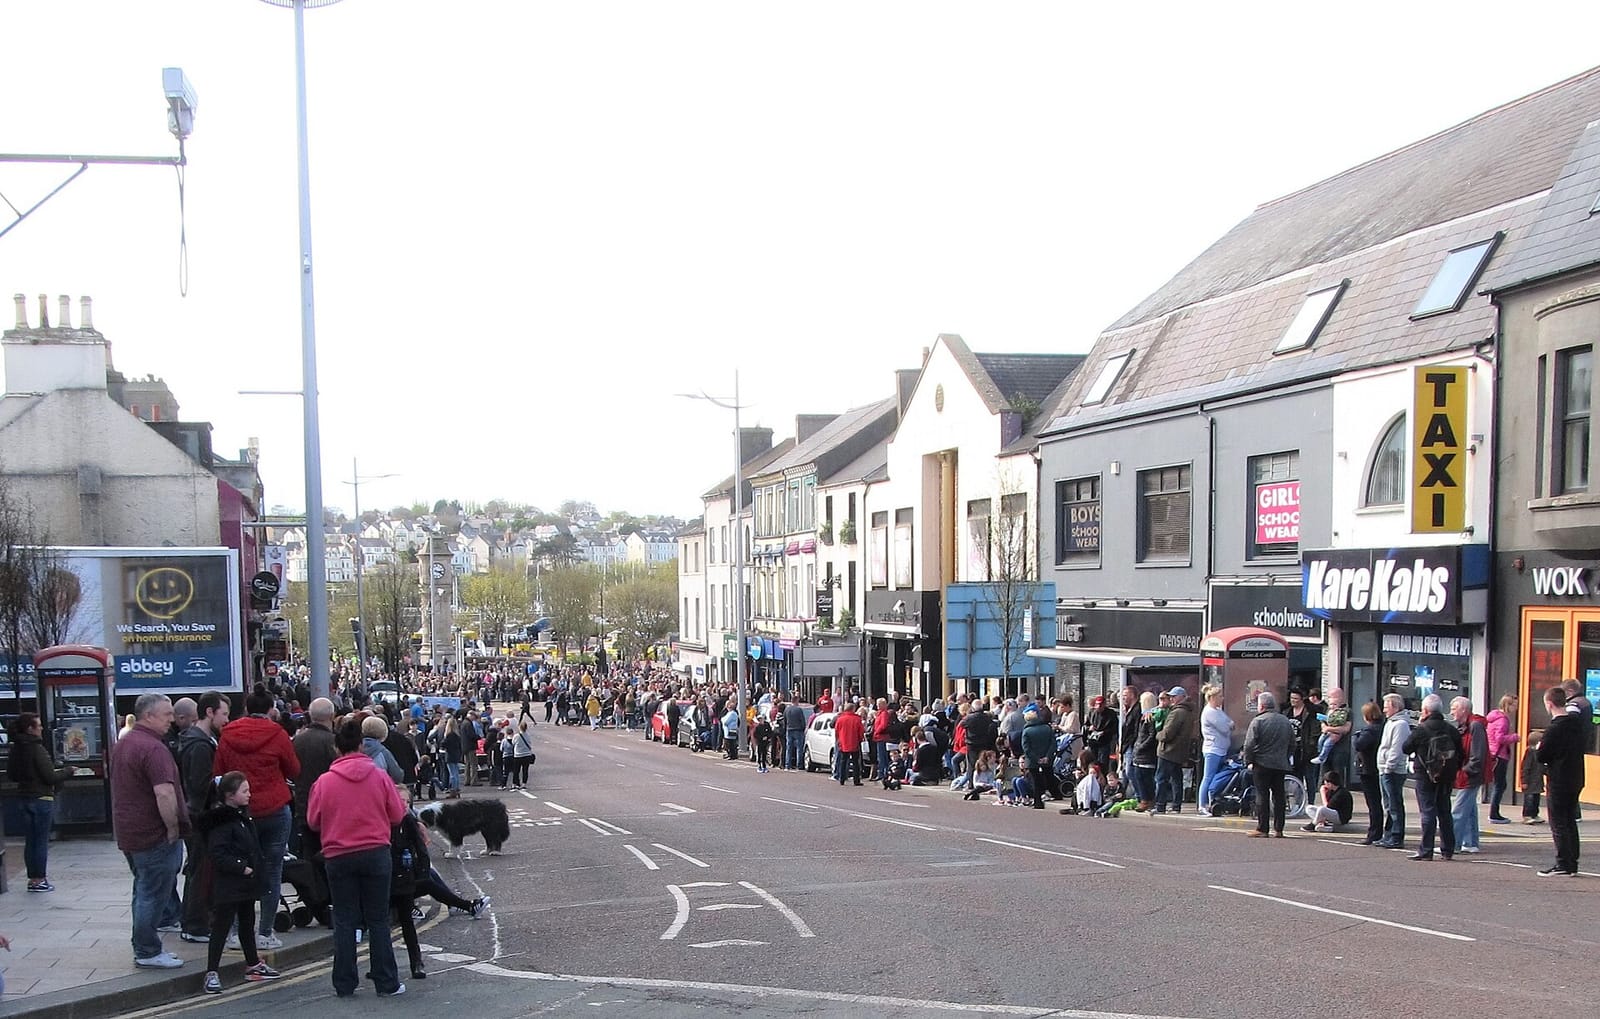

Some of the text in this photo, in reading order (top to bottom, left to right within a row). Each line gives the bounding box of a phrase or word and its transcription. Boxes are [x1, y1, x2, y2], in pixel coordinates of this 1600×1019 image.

[1419, 372, 1458, 528] TAXI
[1259, 511, 1300, 526] SCHOO
[1071, 525, 1099, 537] SCHOO
[1264, 526, 1299, 539] WEAR
[1075, 538, 1098, 548] WEAR
[1532, 567, 1586, 596] WOK
[1253, 606, 1314, 628] schoolwear
[116, 623, 216, 634] We Search, You Save
[121, 633, 212, 643] on home insurance
[1159, 634, 1201, 649] menswear
[120, 658, 174, 676] abbey
